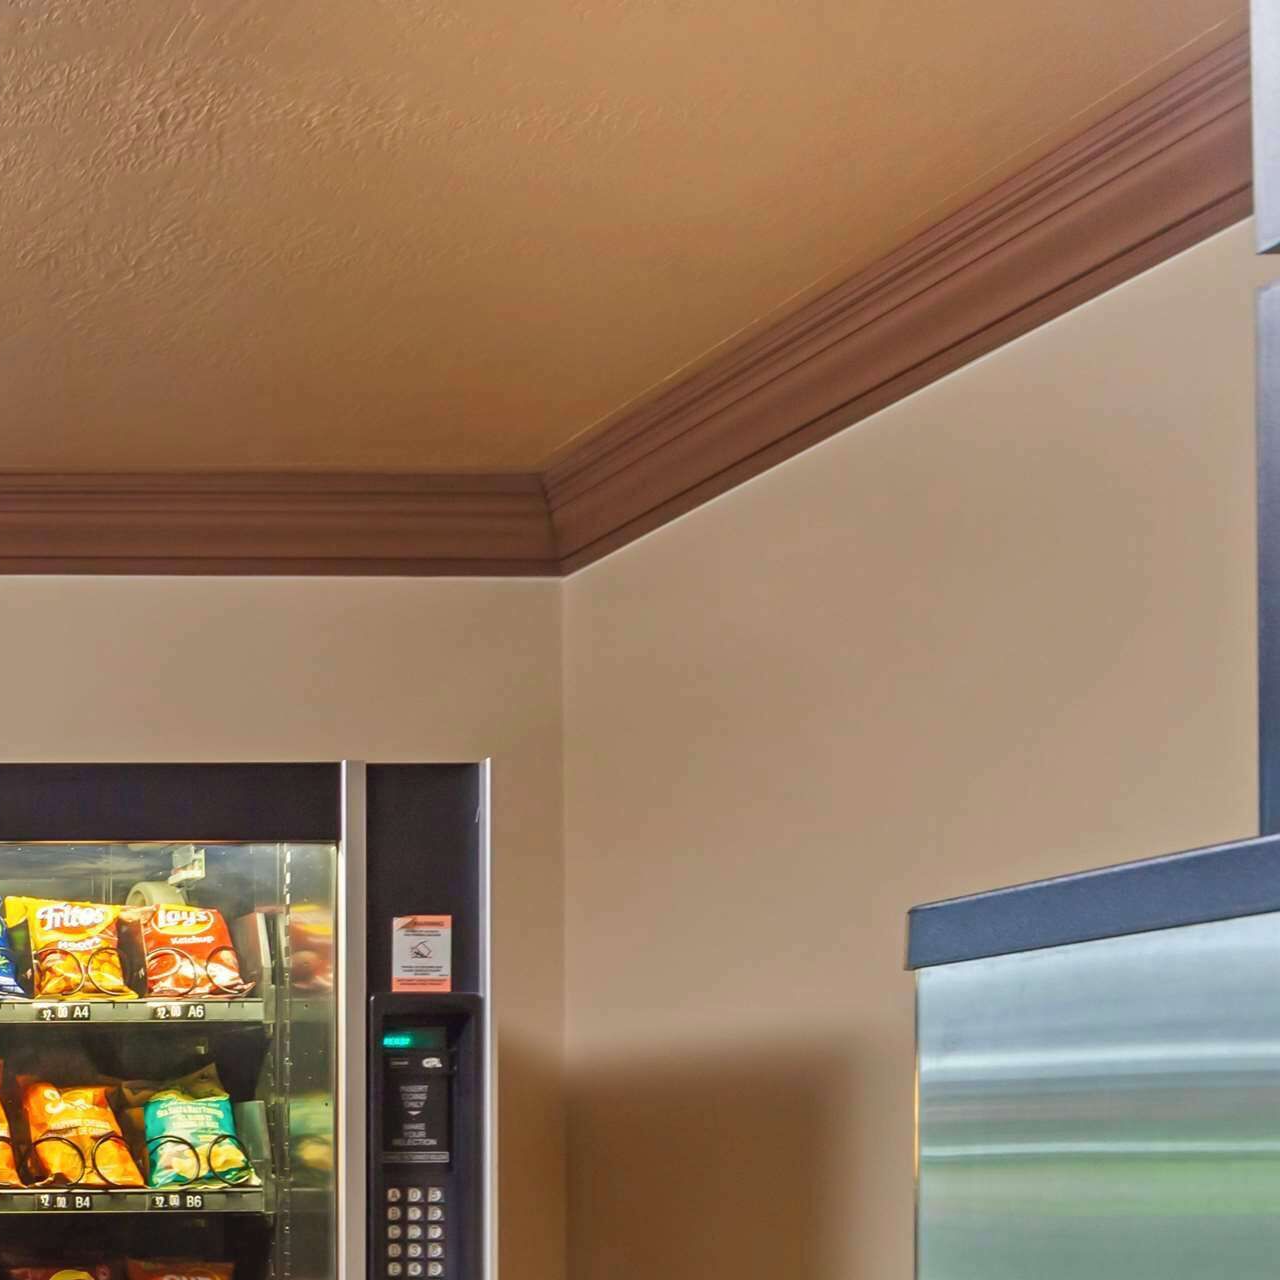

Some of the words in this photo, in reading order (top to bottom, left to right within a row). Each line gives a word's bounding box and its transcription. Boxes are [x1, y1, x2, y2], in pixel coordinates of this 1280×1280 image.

[73, 1007, 89, 1018] A4
[188, 1007, 204, 1018] A6
[75, 1196, 91, 1208] B4
[186, 1195, 202, 1207] B6
